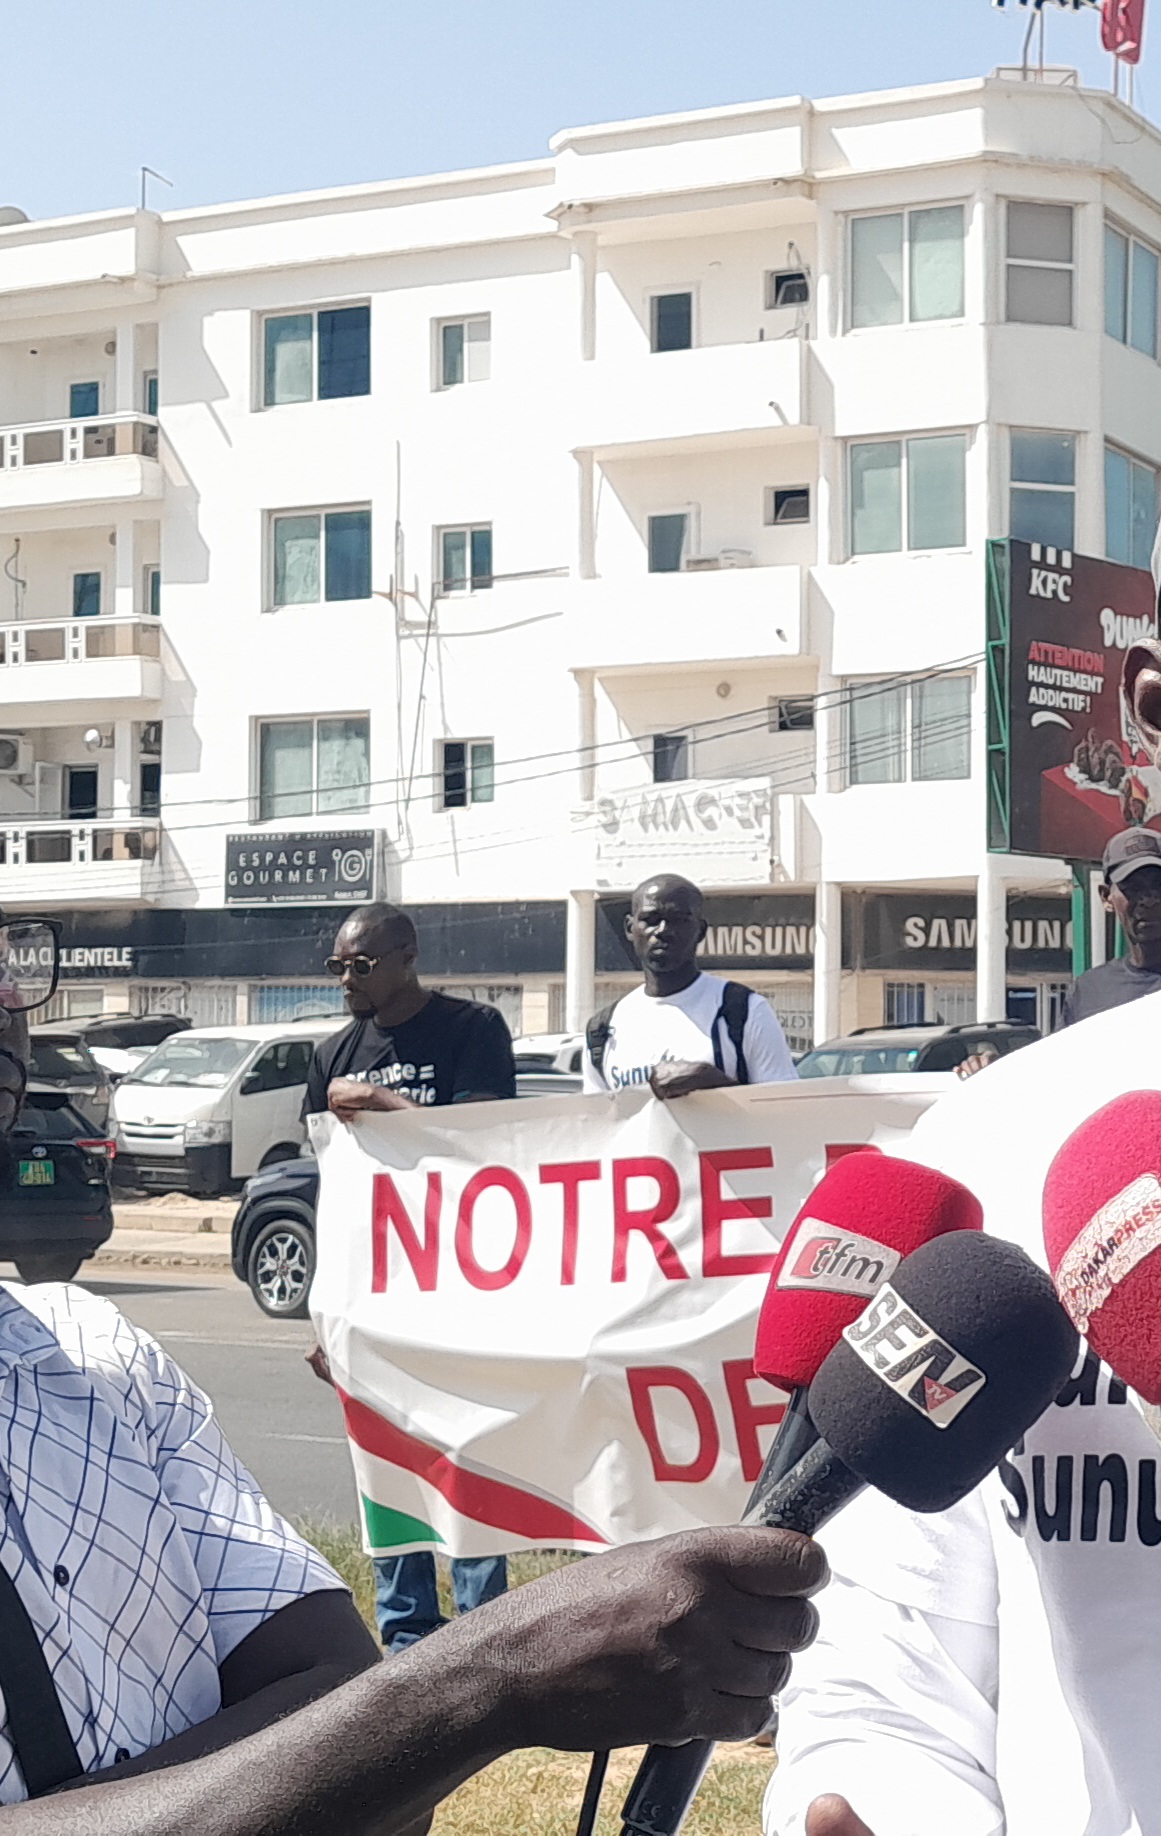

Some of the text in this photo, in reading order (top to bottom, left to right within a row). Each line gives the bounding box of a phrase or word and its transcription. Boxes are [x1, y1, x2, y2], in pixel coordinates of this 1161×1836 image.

[1029, 568, 1072, 602] KFC
[1100, 608, 1158, 649] DUNK
[1028, 641, 1104, 672] ATTENTION
[1028, 664, 1104, 693] HAUTEMENT
[1028, 686, 1092, 713] ADDICTIF!
[239, 851, 317, 867] ESPACE
[228, 868, 328, 886] GOURMET
[695, 925, 815, 957] AMSUN
[371, 1146, 777, 1294] NOTRE
[811, 1242, 884, 1284] tfm
[847, 1290, 983, 1414] SEN
